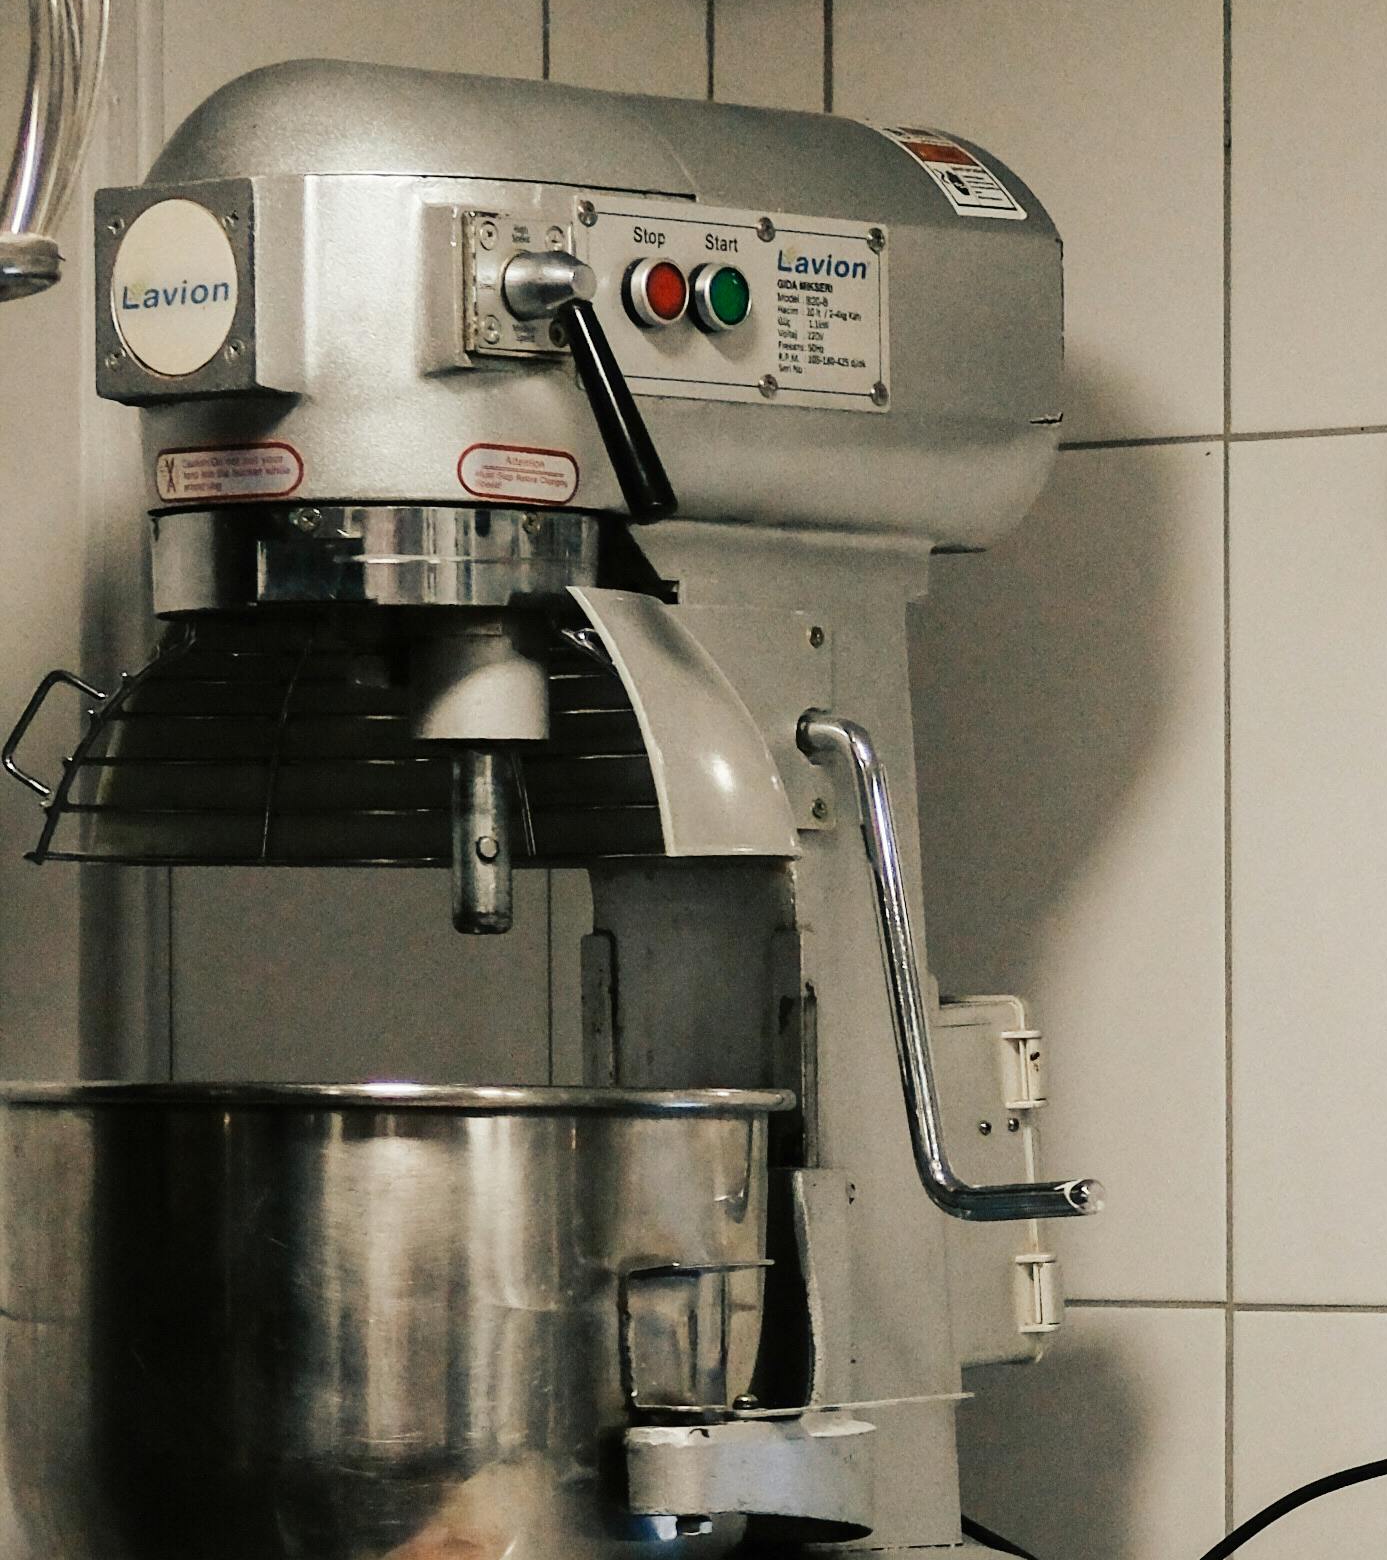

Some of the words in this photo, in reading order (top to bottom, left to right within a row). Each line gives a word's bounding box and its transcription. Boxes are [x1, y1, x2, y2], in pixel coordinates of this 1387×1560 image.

[633, 226, 665, 248] Stop
[705, 233, 738, 253] Start
[777, 250, 867, 279] Lavion
[122, 279, 230, 310] Lavion
[777, 279, 798, 290] GIDA
[777, 292, 799, 303] Model
